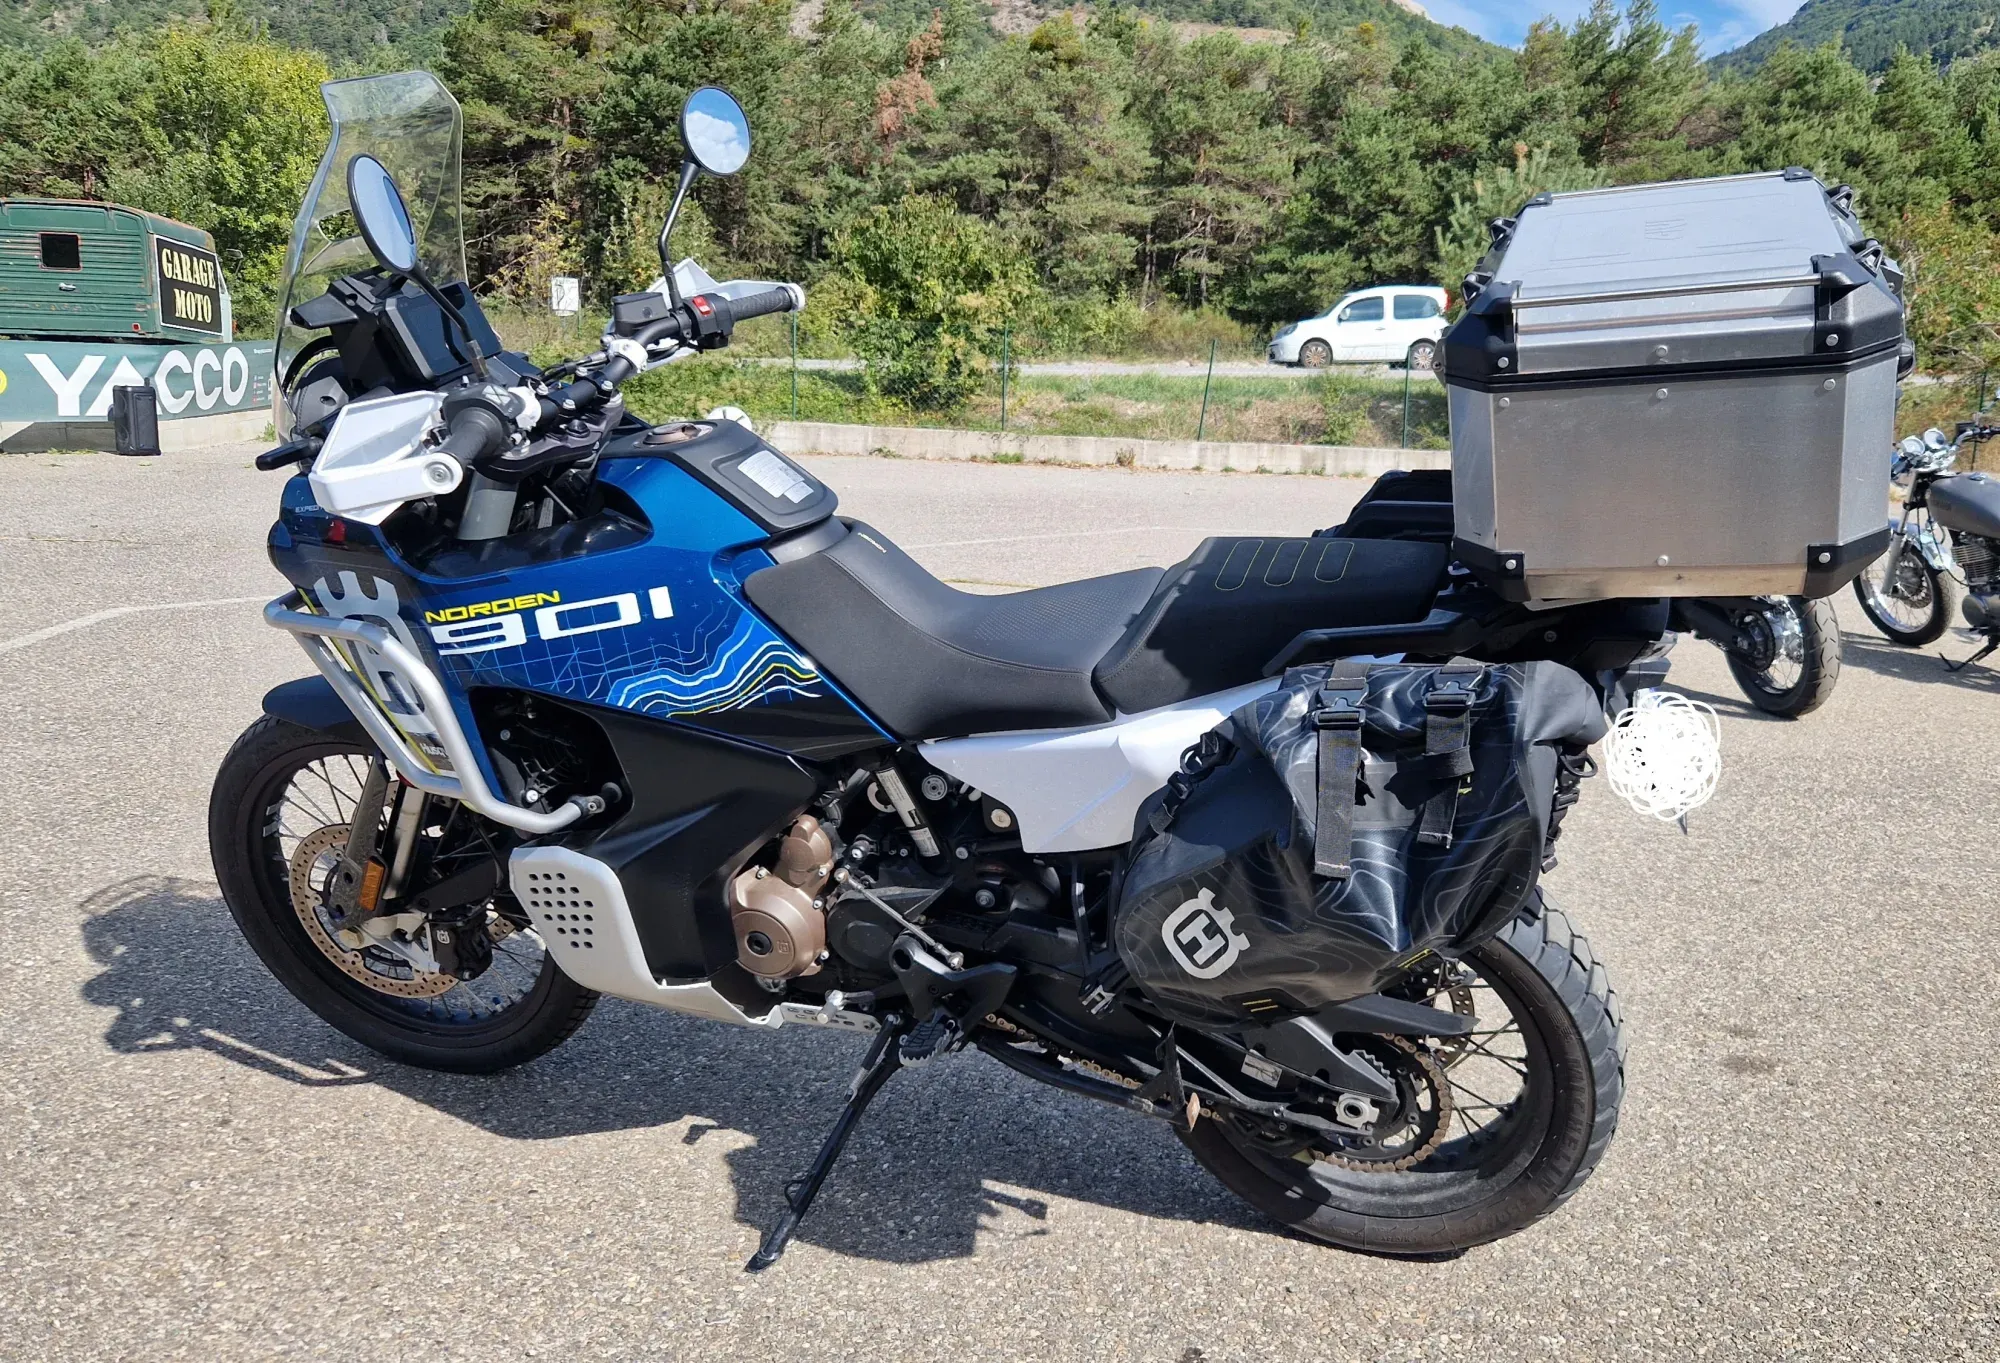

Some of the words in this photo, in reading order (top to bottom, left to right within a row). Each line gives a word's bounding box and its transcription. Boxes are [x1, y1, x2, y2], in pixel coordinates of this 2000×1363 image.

[161, 247, 216, 290] GARAGE
[173, 288, 212, 324] MOTO
[24, 346, 249, 417] YACCO
[295, 504, 323, 513] EXPED
[424, 590, 561, 624] NORDEN
[430, 585, 674, 656] 901
[1536, 1055, 1586, 1195] MICHELIN
